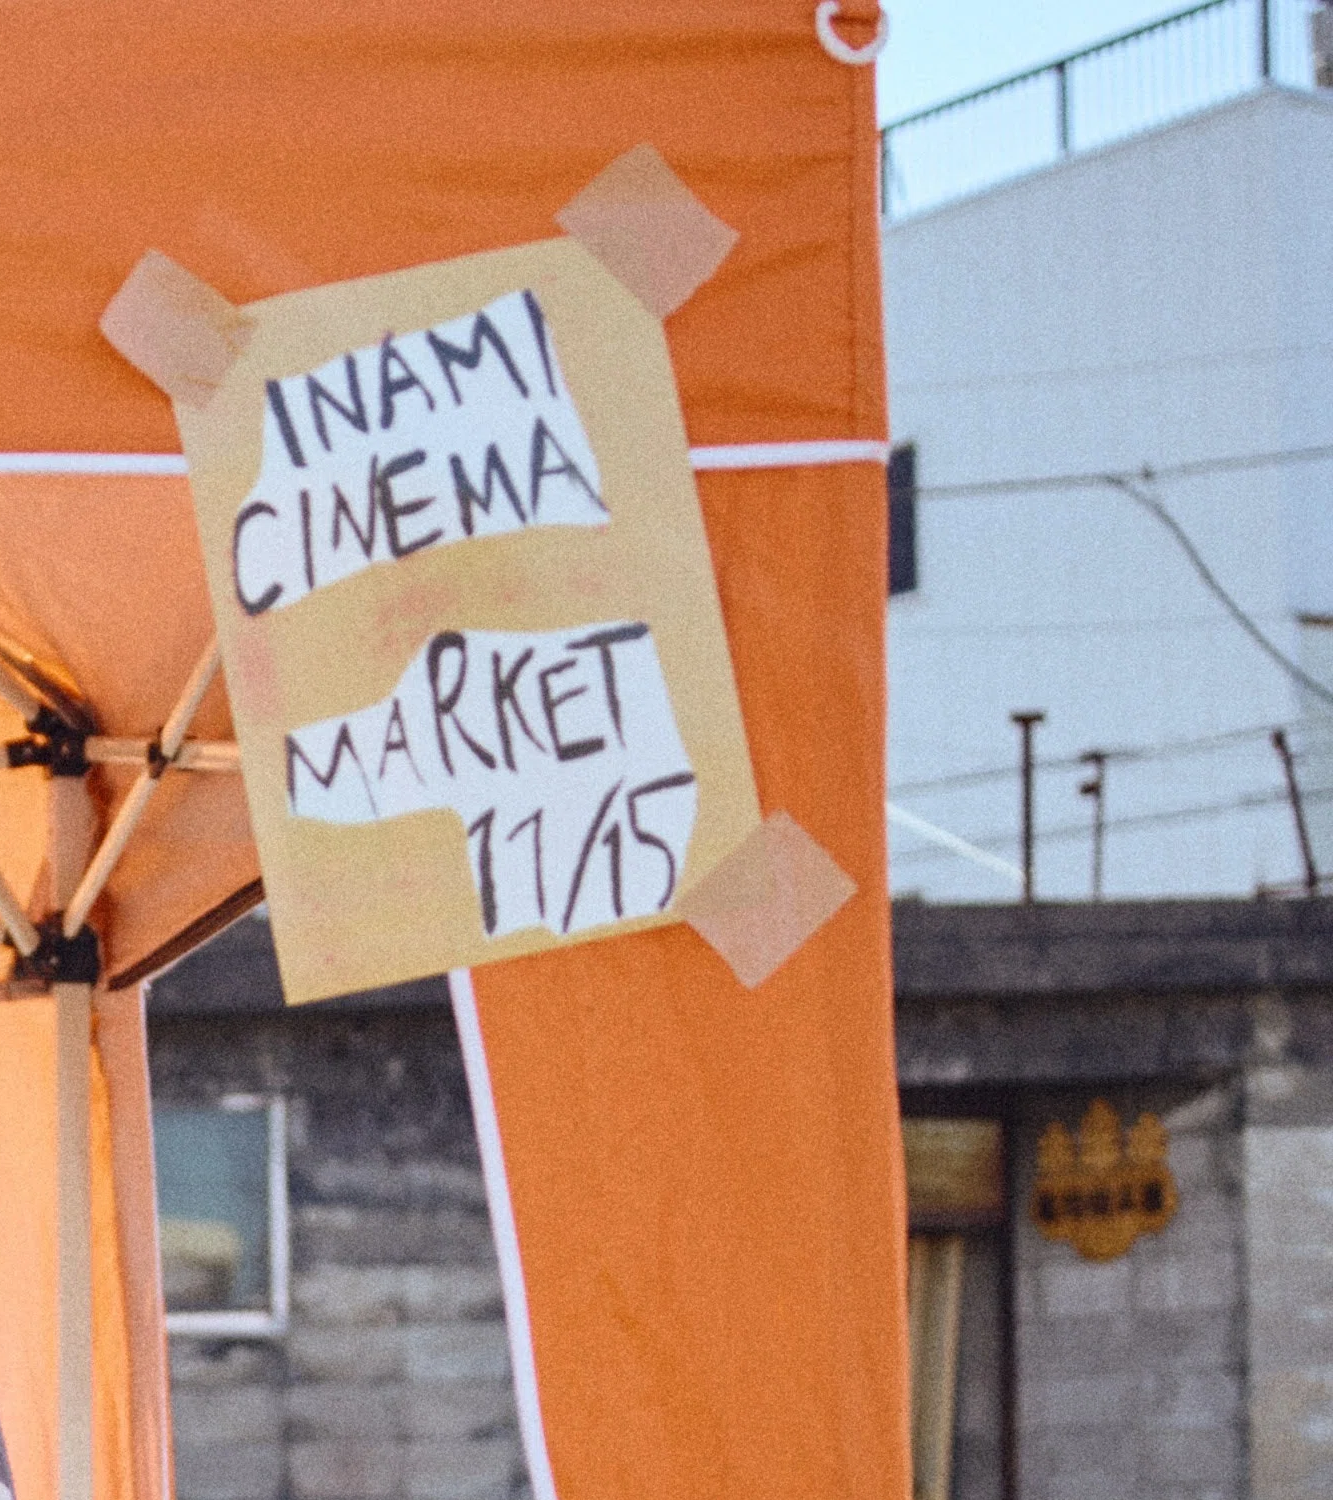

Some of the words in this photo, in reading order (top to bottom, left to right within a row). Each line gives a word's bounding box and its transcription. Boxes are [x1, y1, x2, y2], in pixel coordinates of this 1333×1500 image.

[264, 289, 558, 469] INAMI
[231, 417, 610, 616] CINEMA
[285, 621, 651, 817] MARKET
[468, 771, 696, 935] 11/15
